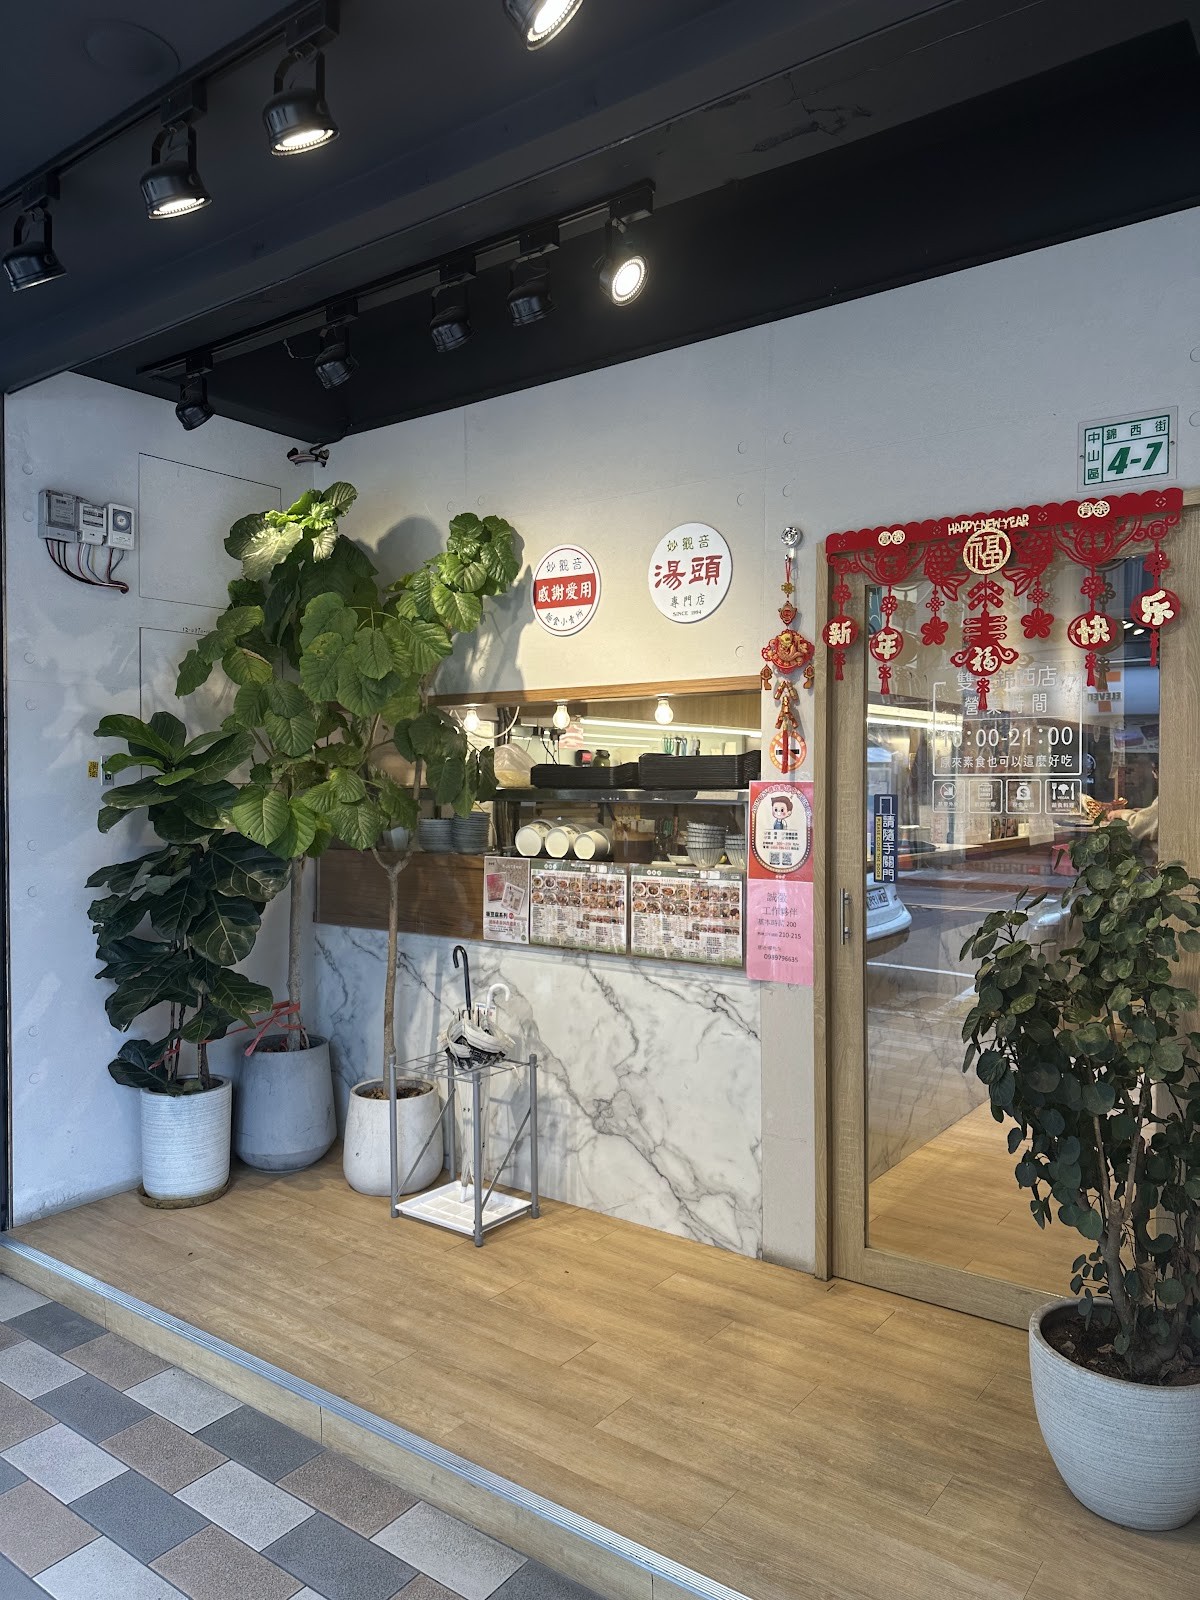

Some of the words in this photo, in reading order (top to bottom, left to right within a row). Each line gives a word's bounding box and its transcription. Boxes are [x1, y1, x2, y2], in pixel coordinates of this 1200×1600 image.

[1106, 419, 1167, 441] 錦西街
[1087, 431, 1101, 480] 中山區
[1107, 441, 1164, 475] 4-7
[947, 520, 978, 536] HAPPY
[979, 518, 1001, 530] NEW
[1001, 513, 1030, 529] YEAR
[667, 535, 710, 552] 妙觀音
[968, 533, 1007, 571] 福
[546, 557, 582, 573] 妙觀音
[654, 555, 723, 591] 湯頭
[537, 581, 592, 603] 感謝愛用
[670, 593, 705, 609] 專門店
[1141, 590, 1175, 626] 乐
[828, 621, 852, 647] 新
[1076, 614, 1111, 646] 快
[875, 632, 899, 660] 年
[970, 646, 999, 672] 福
[956, 666, 1057, 692] 雙錦西店
[964, 693, 1047, 716] 營業時間
[940, 755, 1073, 769] 原來素食也可以這麼好吃
[882, 815, 895, 882] 請隨手關門
